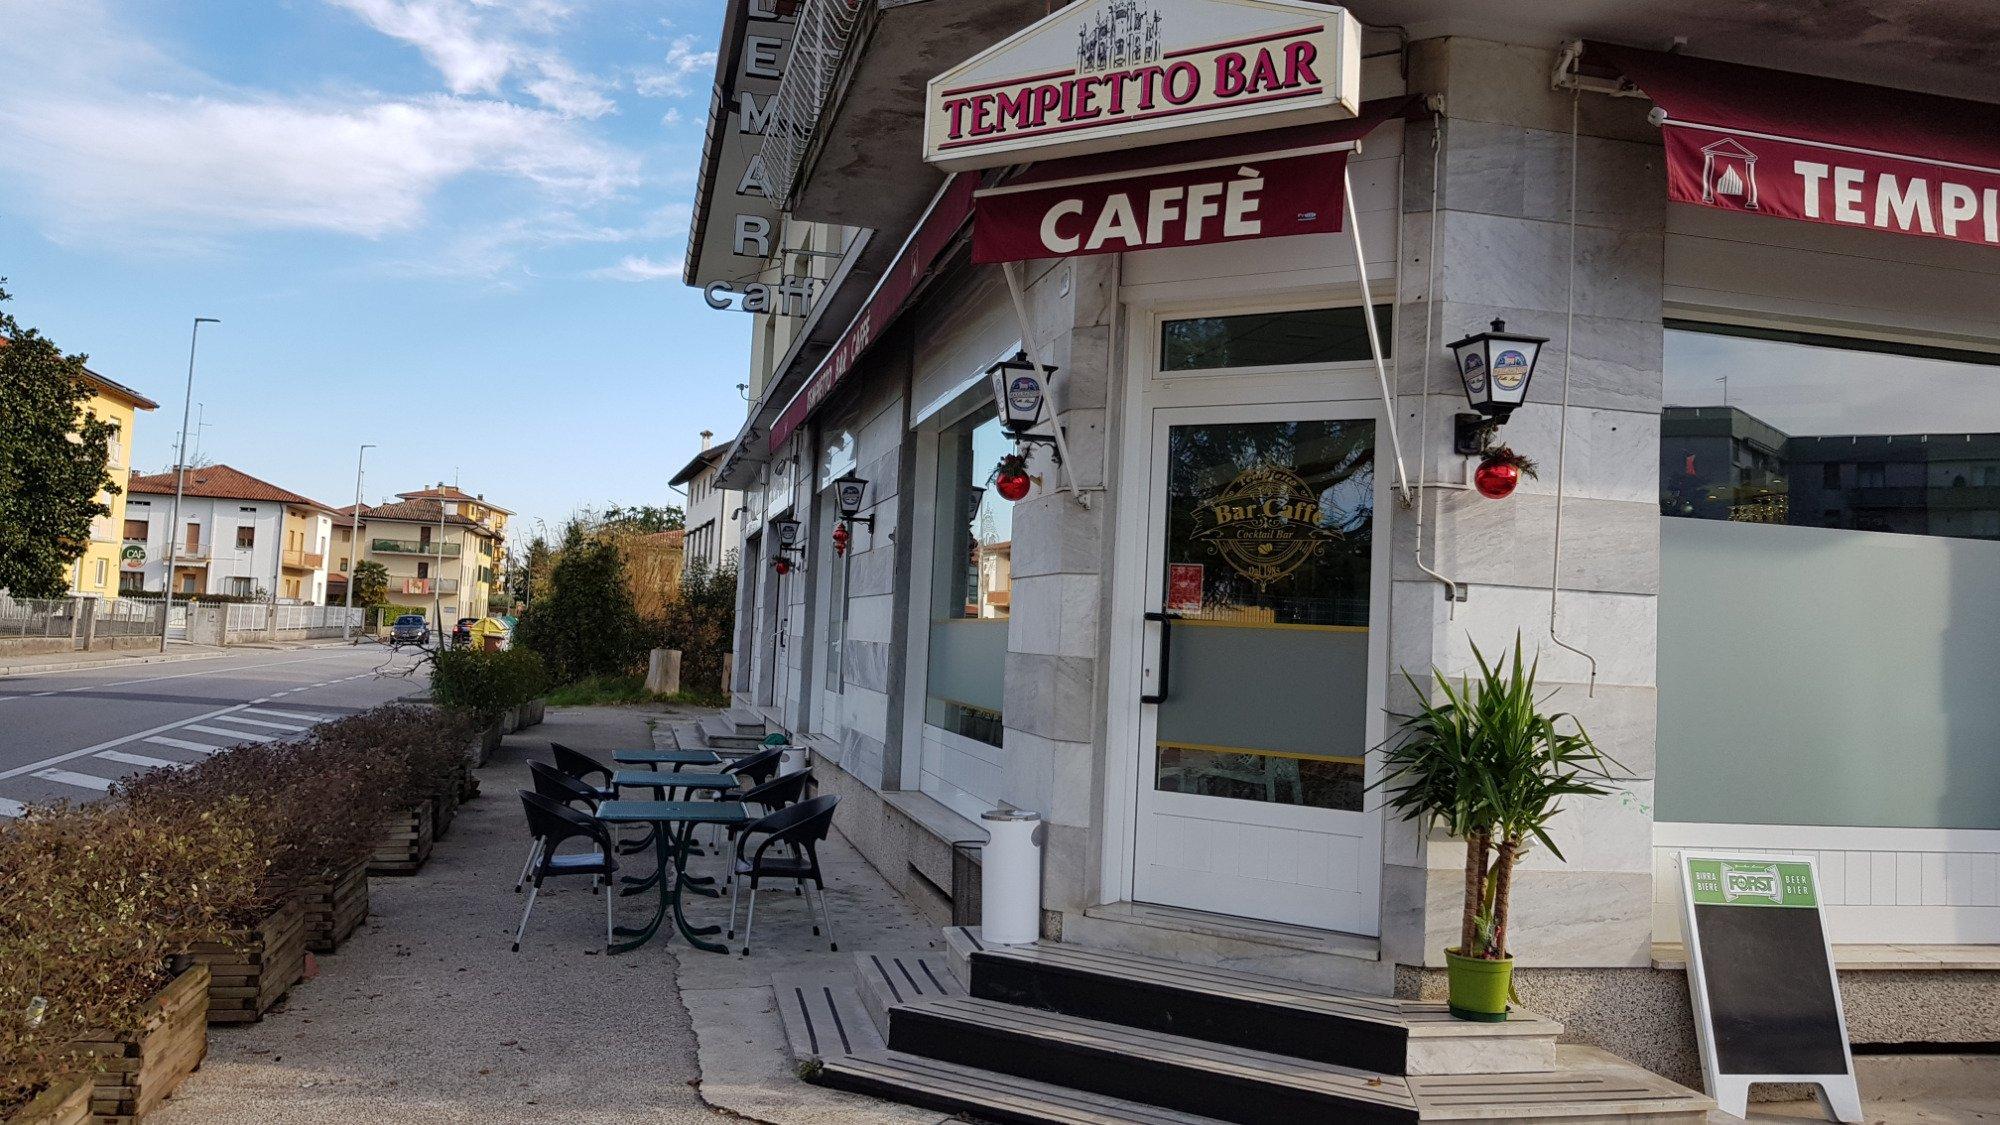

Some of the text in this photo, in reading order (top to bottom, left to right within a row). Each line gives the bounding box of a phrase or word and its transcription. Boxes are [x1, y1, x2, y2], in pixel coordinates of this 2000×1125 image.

[942, 40, 1322, 139] TEMPIETTO BAR
[1040, 166, 1264, 253] CAFFÈ
[704, 274, 824, 318] caff
[1215, 504, 1256, 524] Bar
[1236, 529, 1294, 539] Cocktail Bar
[1695, 871, 1717, 881] BIRRA
[1728, 874, 1775, 892] FORST
[1784, 875, 1807, 884] BEER
[1787, 885, 1809, 895] BIER
